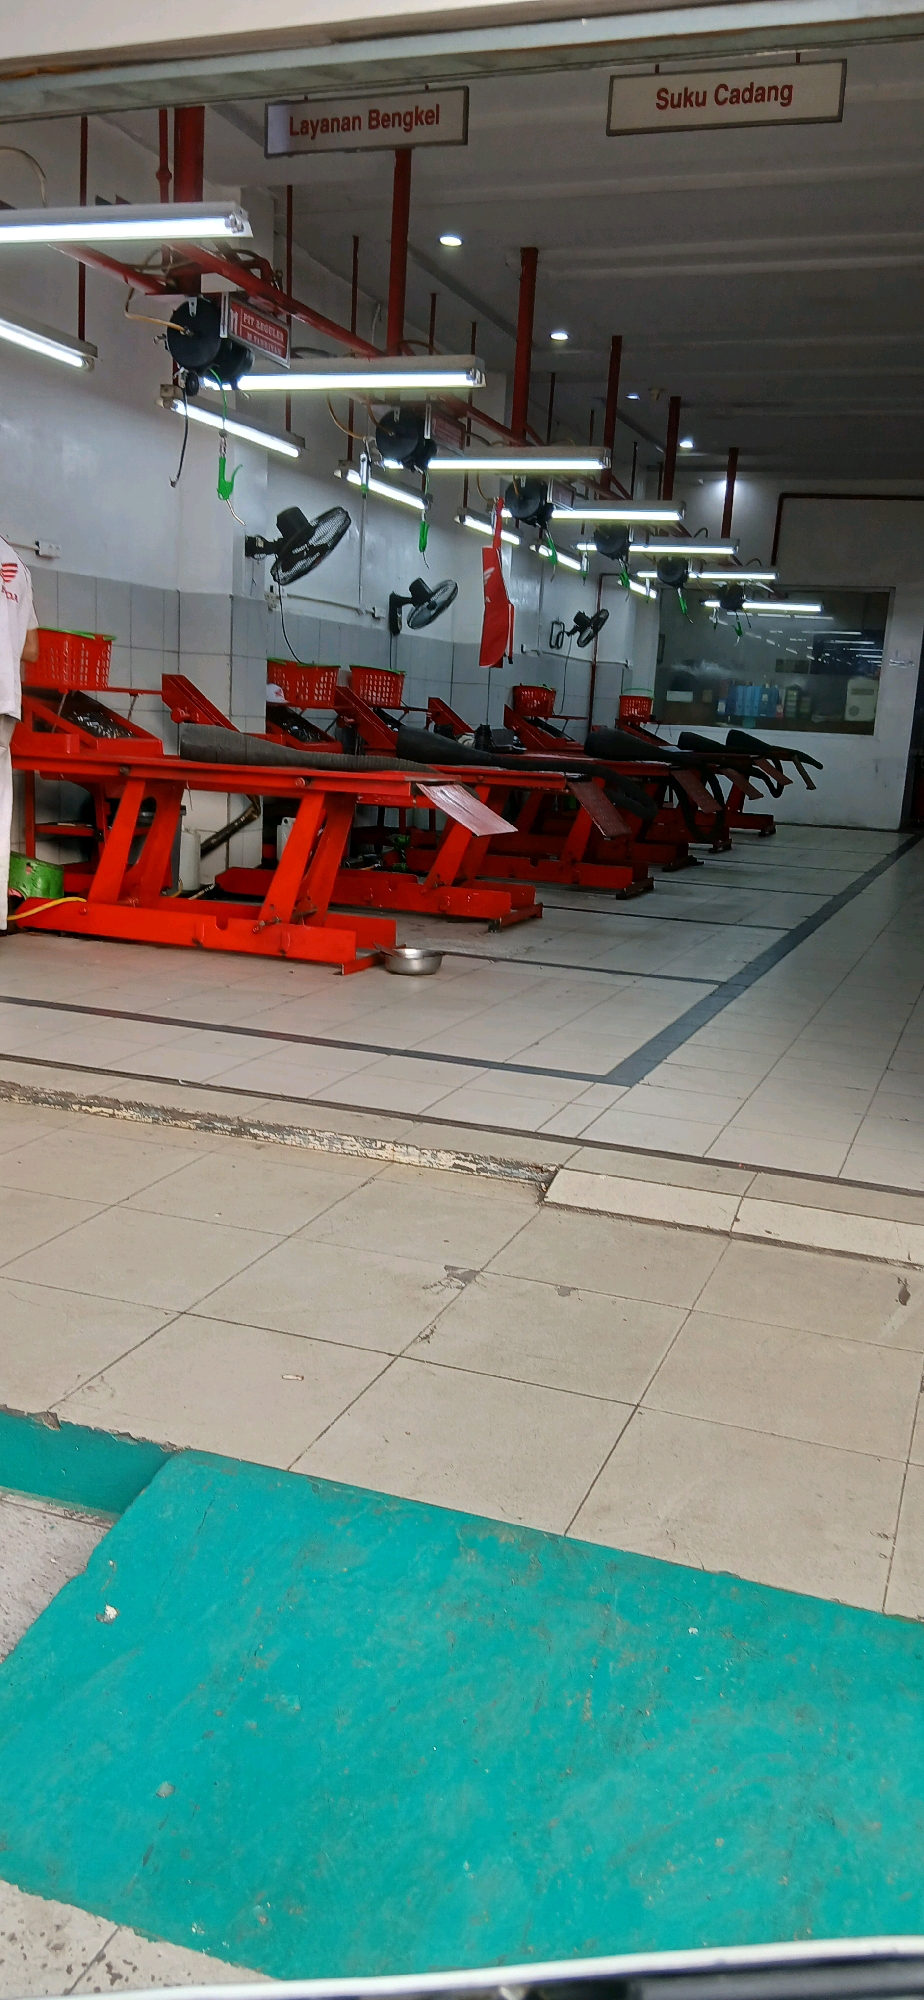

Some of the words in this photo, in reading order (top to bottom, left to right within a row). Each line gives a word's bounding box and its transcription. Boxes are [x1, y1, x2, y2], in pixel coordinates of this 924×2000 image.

[656, 86, 707, 110] Suku
[714, 82, 793, 107] Cadang
[289, 116, 362, 140] Layanan
[368, 103, 440, 133] Bengkel
